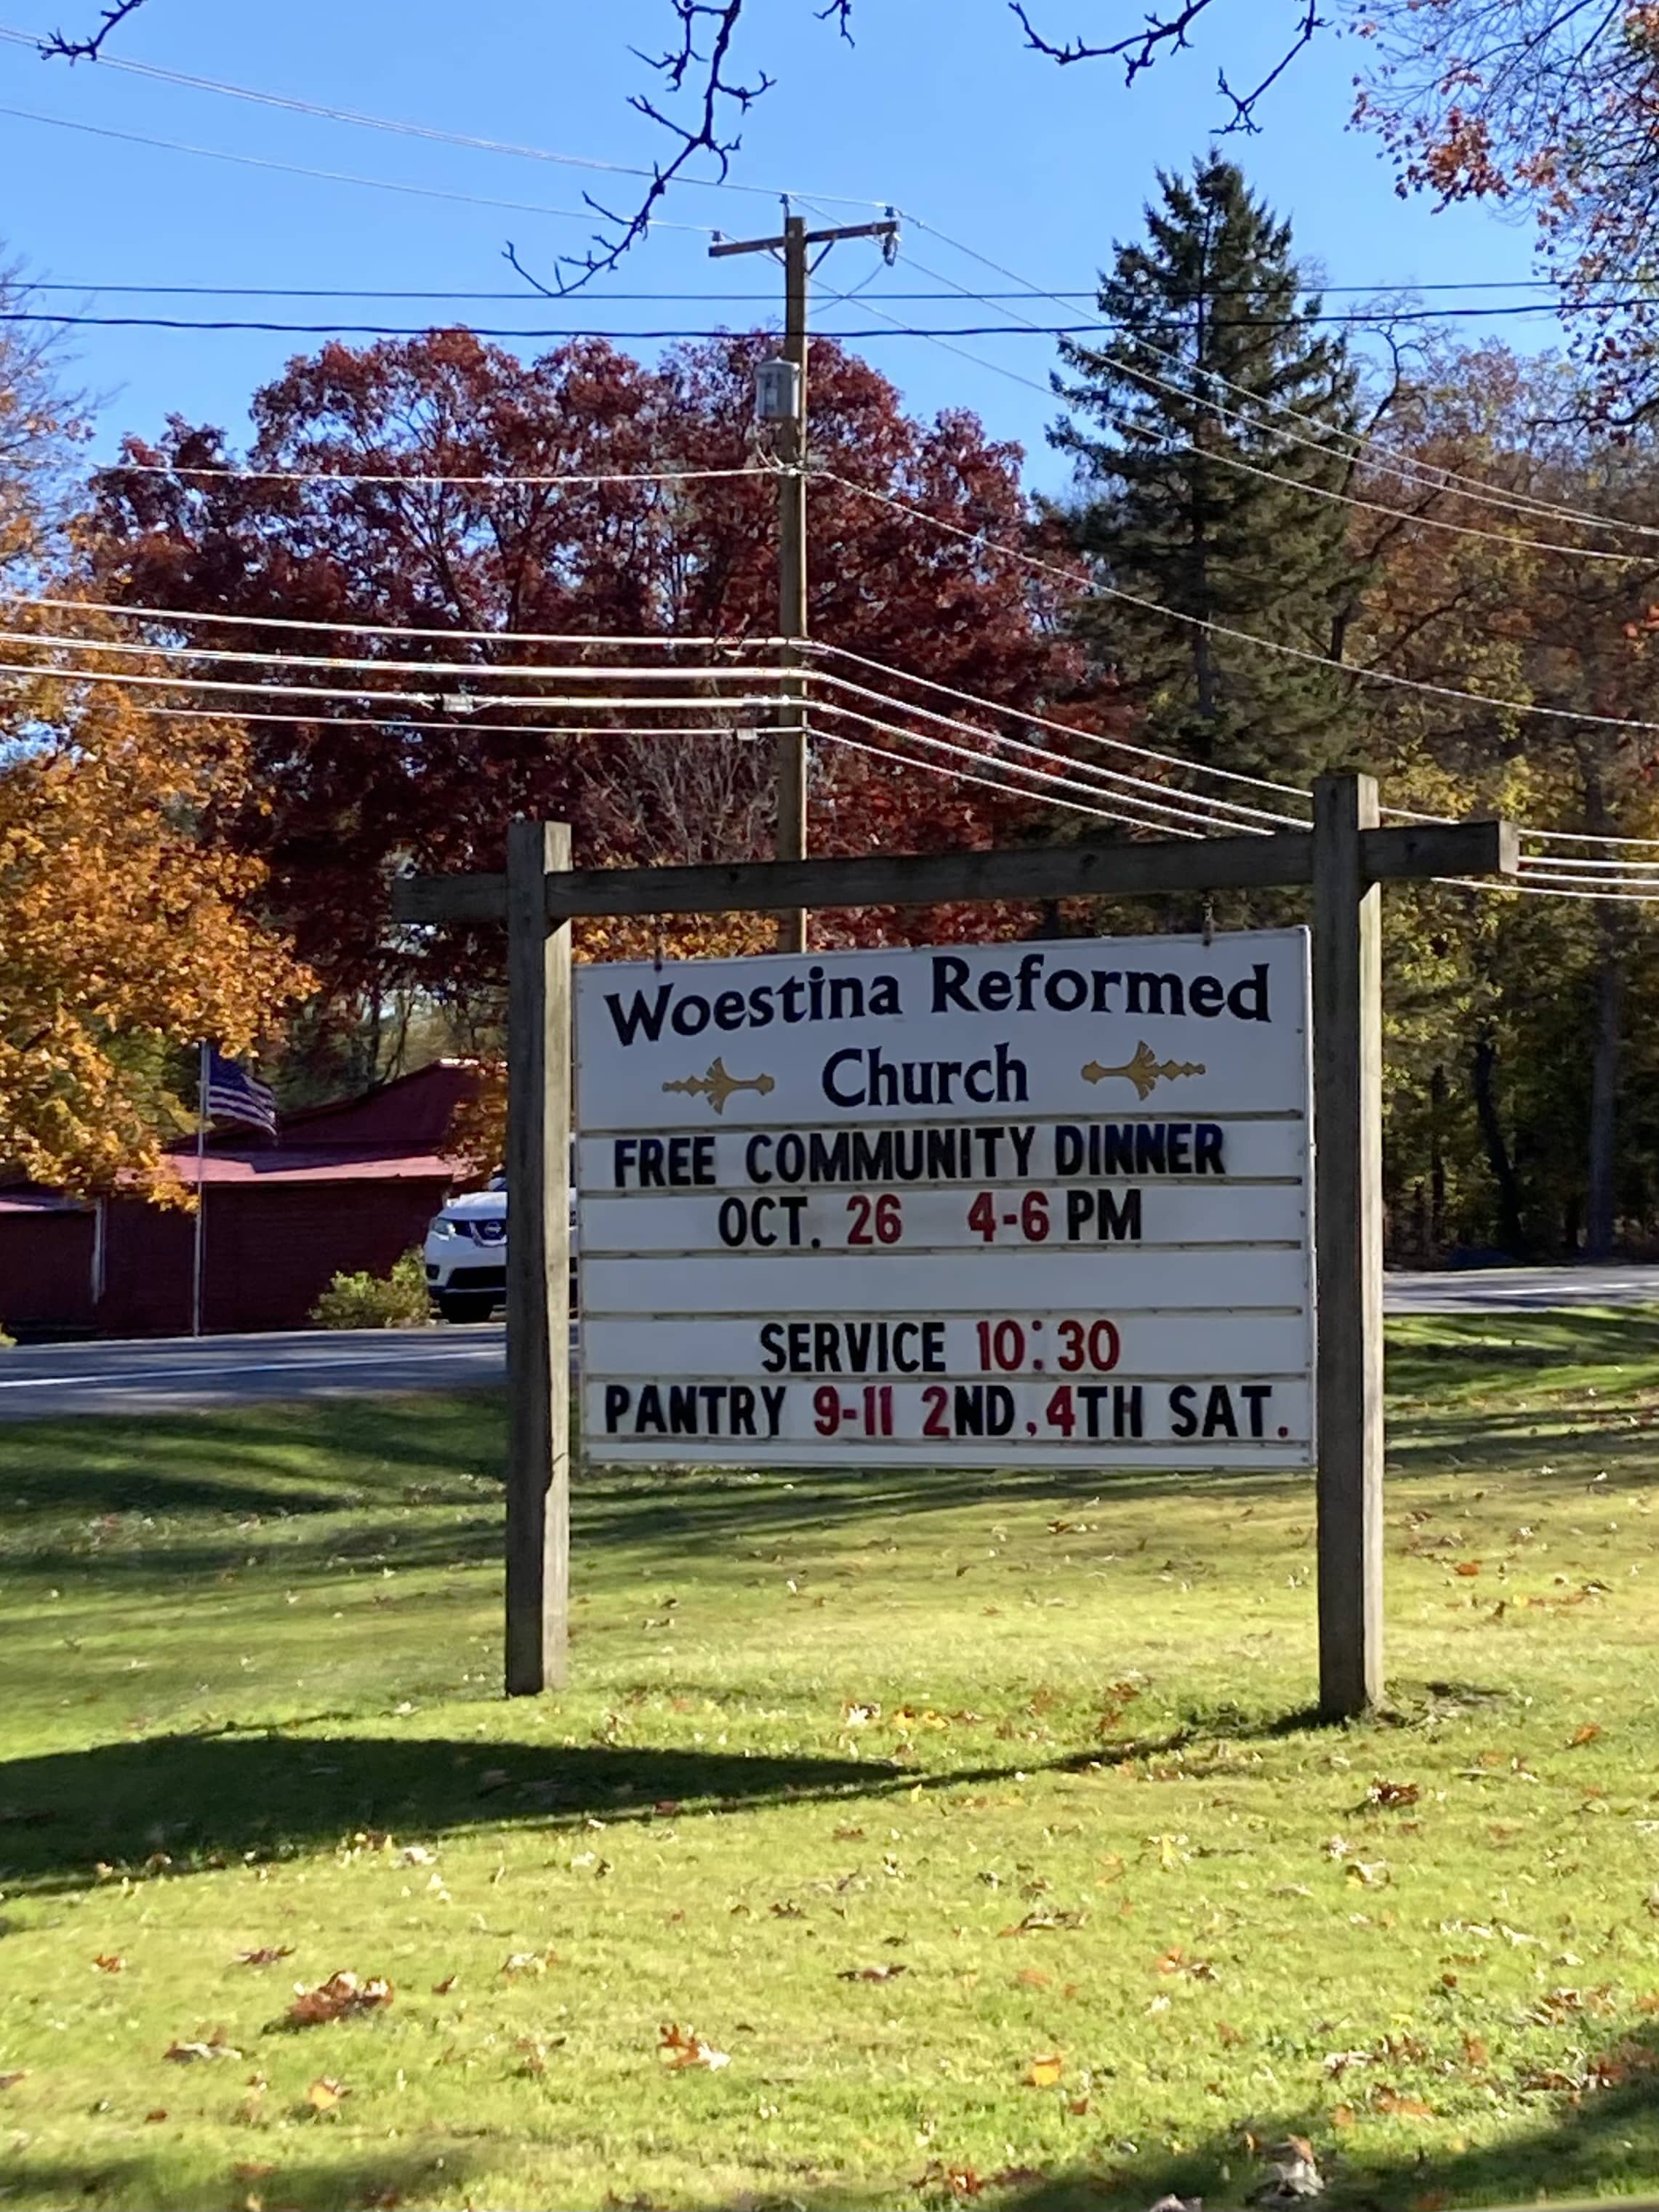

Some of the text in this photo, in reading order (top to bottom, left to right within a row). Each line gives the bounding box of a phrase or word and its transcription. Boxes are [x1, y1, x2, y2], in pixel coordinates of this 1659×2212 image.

[604, 954, 1272, 1046] Woestina Reformed
[822, 1042, 1029, 1107] Church
[614, 1123, 1226, 1188] FREE COMMUNITY DINNER
[718, 1189, 1142, 1249] OCT. 26 4-6 PM
[760, 1319, 1120, 1373] SERVICE 10:30
[605, 1385, 787, 1438] PANTRY
[813, 1385, 893, 1436] 9-11
[1168, 1385, 1288, 1437] SAT.
